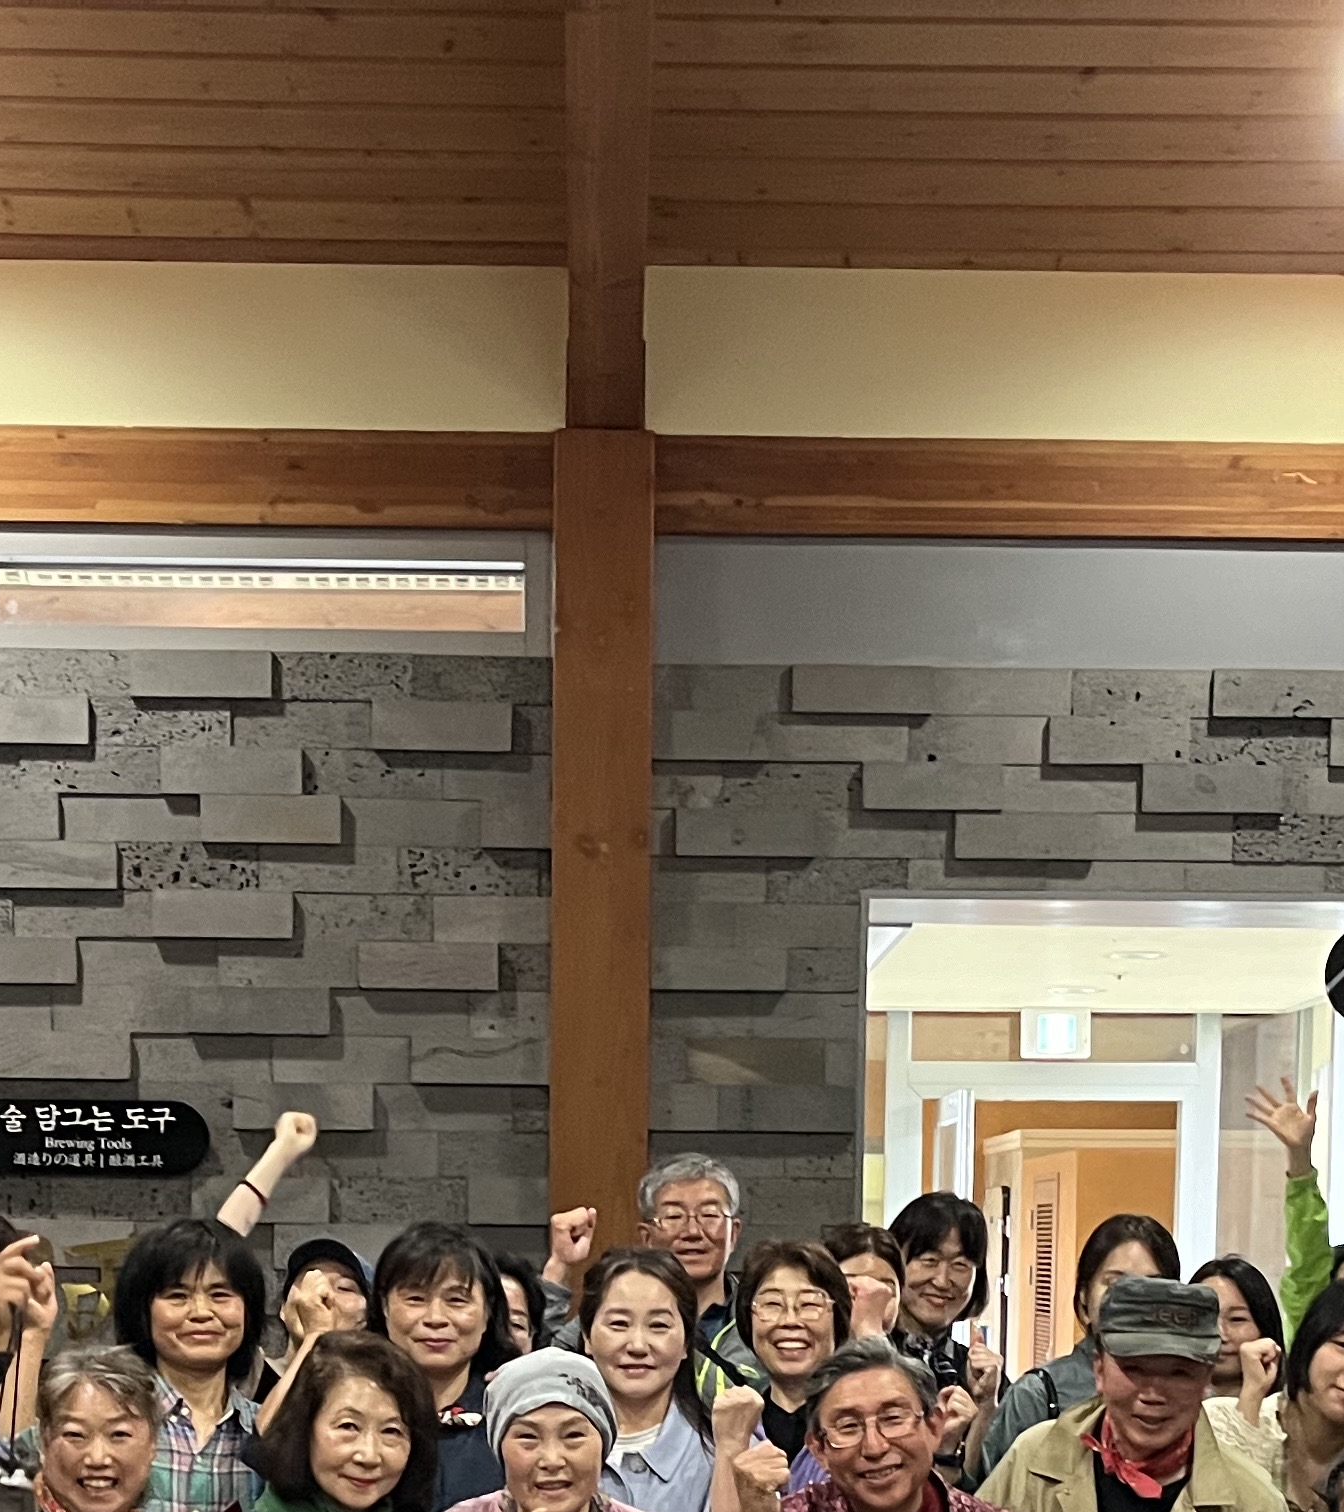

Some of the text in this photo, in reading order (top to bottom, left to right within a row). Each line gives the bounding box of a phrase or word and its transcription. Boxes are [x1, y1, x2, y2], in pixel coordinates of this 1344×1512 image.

[0, 1104, 177, 1134] 술 담그는 도구
[44, 1136, 133, 1152] Brewing Tools
